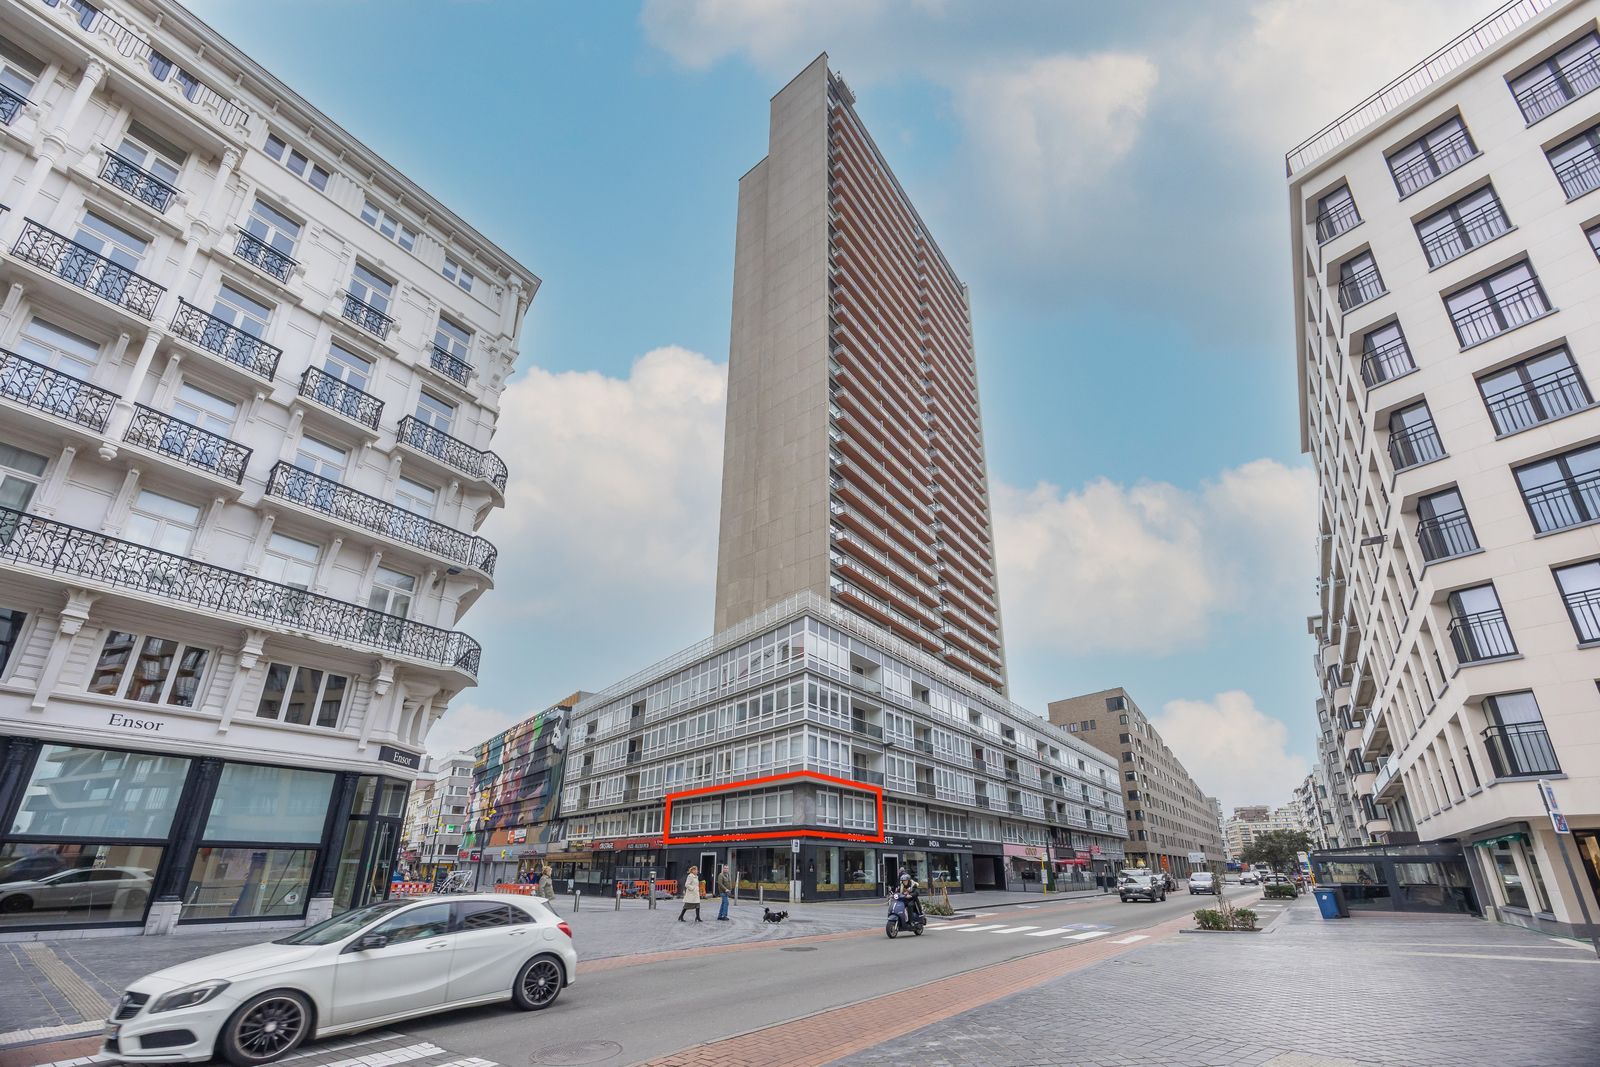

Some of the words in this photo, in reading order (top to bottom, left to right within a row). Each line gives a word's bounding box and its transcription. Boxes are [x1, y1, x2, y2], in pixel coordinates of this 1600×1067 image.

[109, 713, 164, 730] Ensor
[393, 751, 412, 766] Ensor
[908, 838, 915, 846] OF
[928, 840, 940, 848] INDIA
